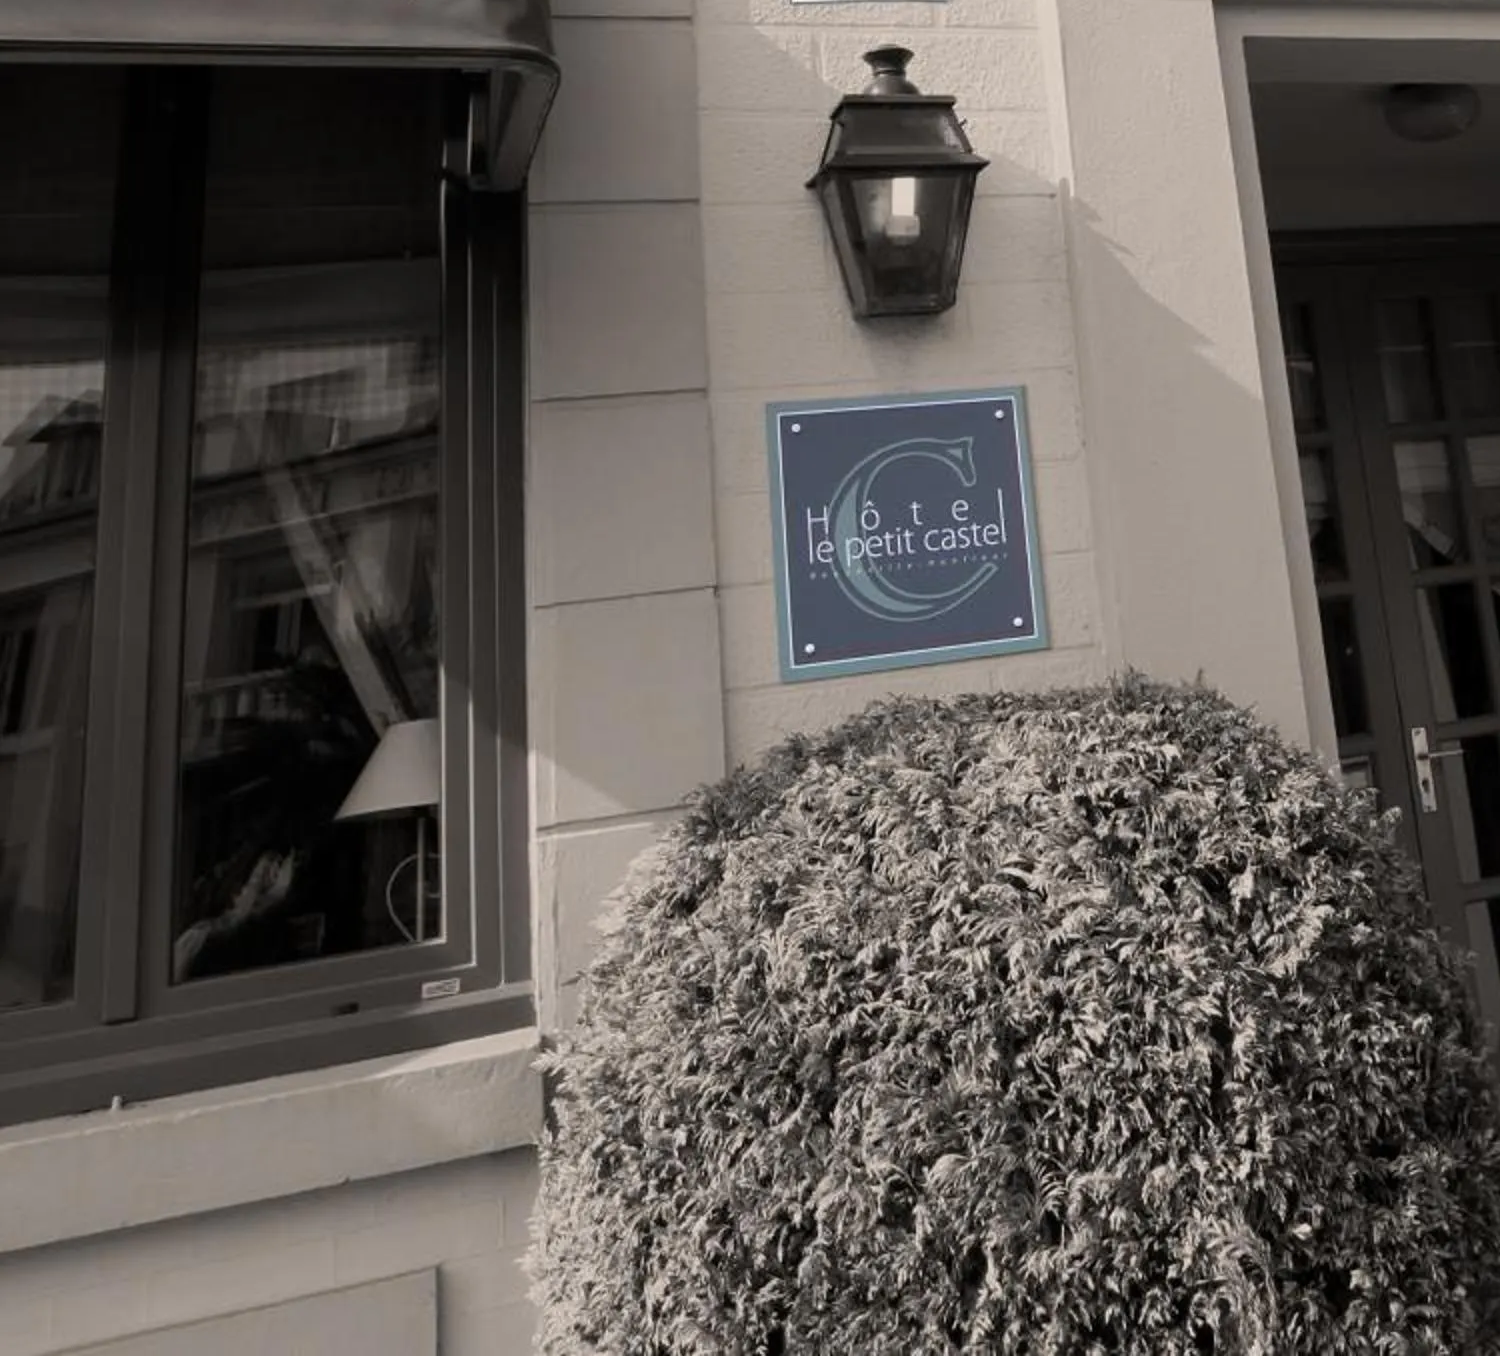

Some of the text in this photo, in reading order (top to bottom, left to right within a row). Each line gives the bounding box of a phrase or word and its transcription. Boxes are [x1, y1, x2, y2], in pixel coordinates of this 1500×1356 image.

[806, 486, 1004, 536] Hôtel
[806, 522, 835, 564] le
[845, 528, 916, 567] petit
[923, 506, 1007, 552] castel
